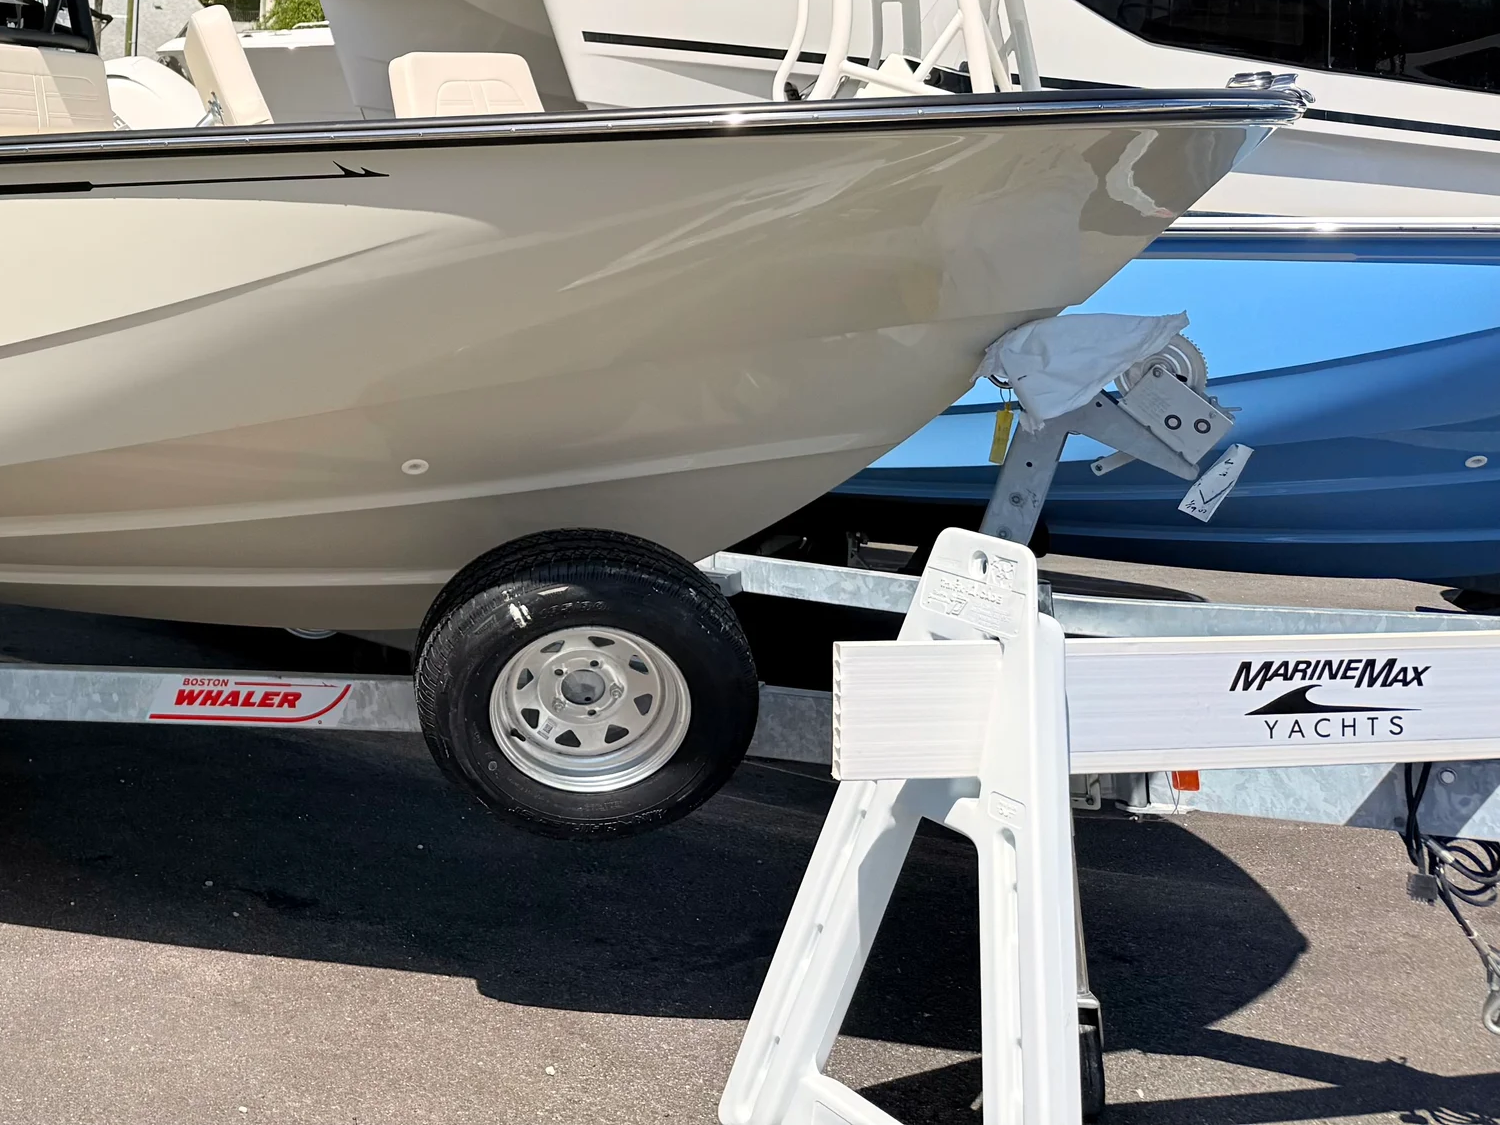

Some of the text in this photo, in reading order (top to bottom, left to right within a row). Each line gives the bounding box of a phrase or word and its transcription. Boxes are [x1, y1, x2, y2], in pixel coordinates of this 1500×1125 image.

[182, 677, 229, 687] BOSTON
[174, 688, 302, 709] WHALER
[1264, 715, 1404, 739] YACHTS
